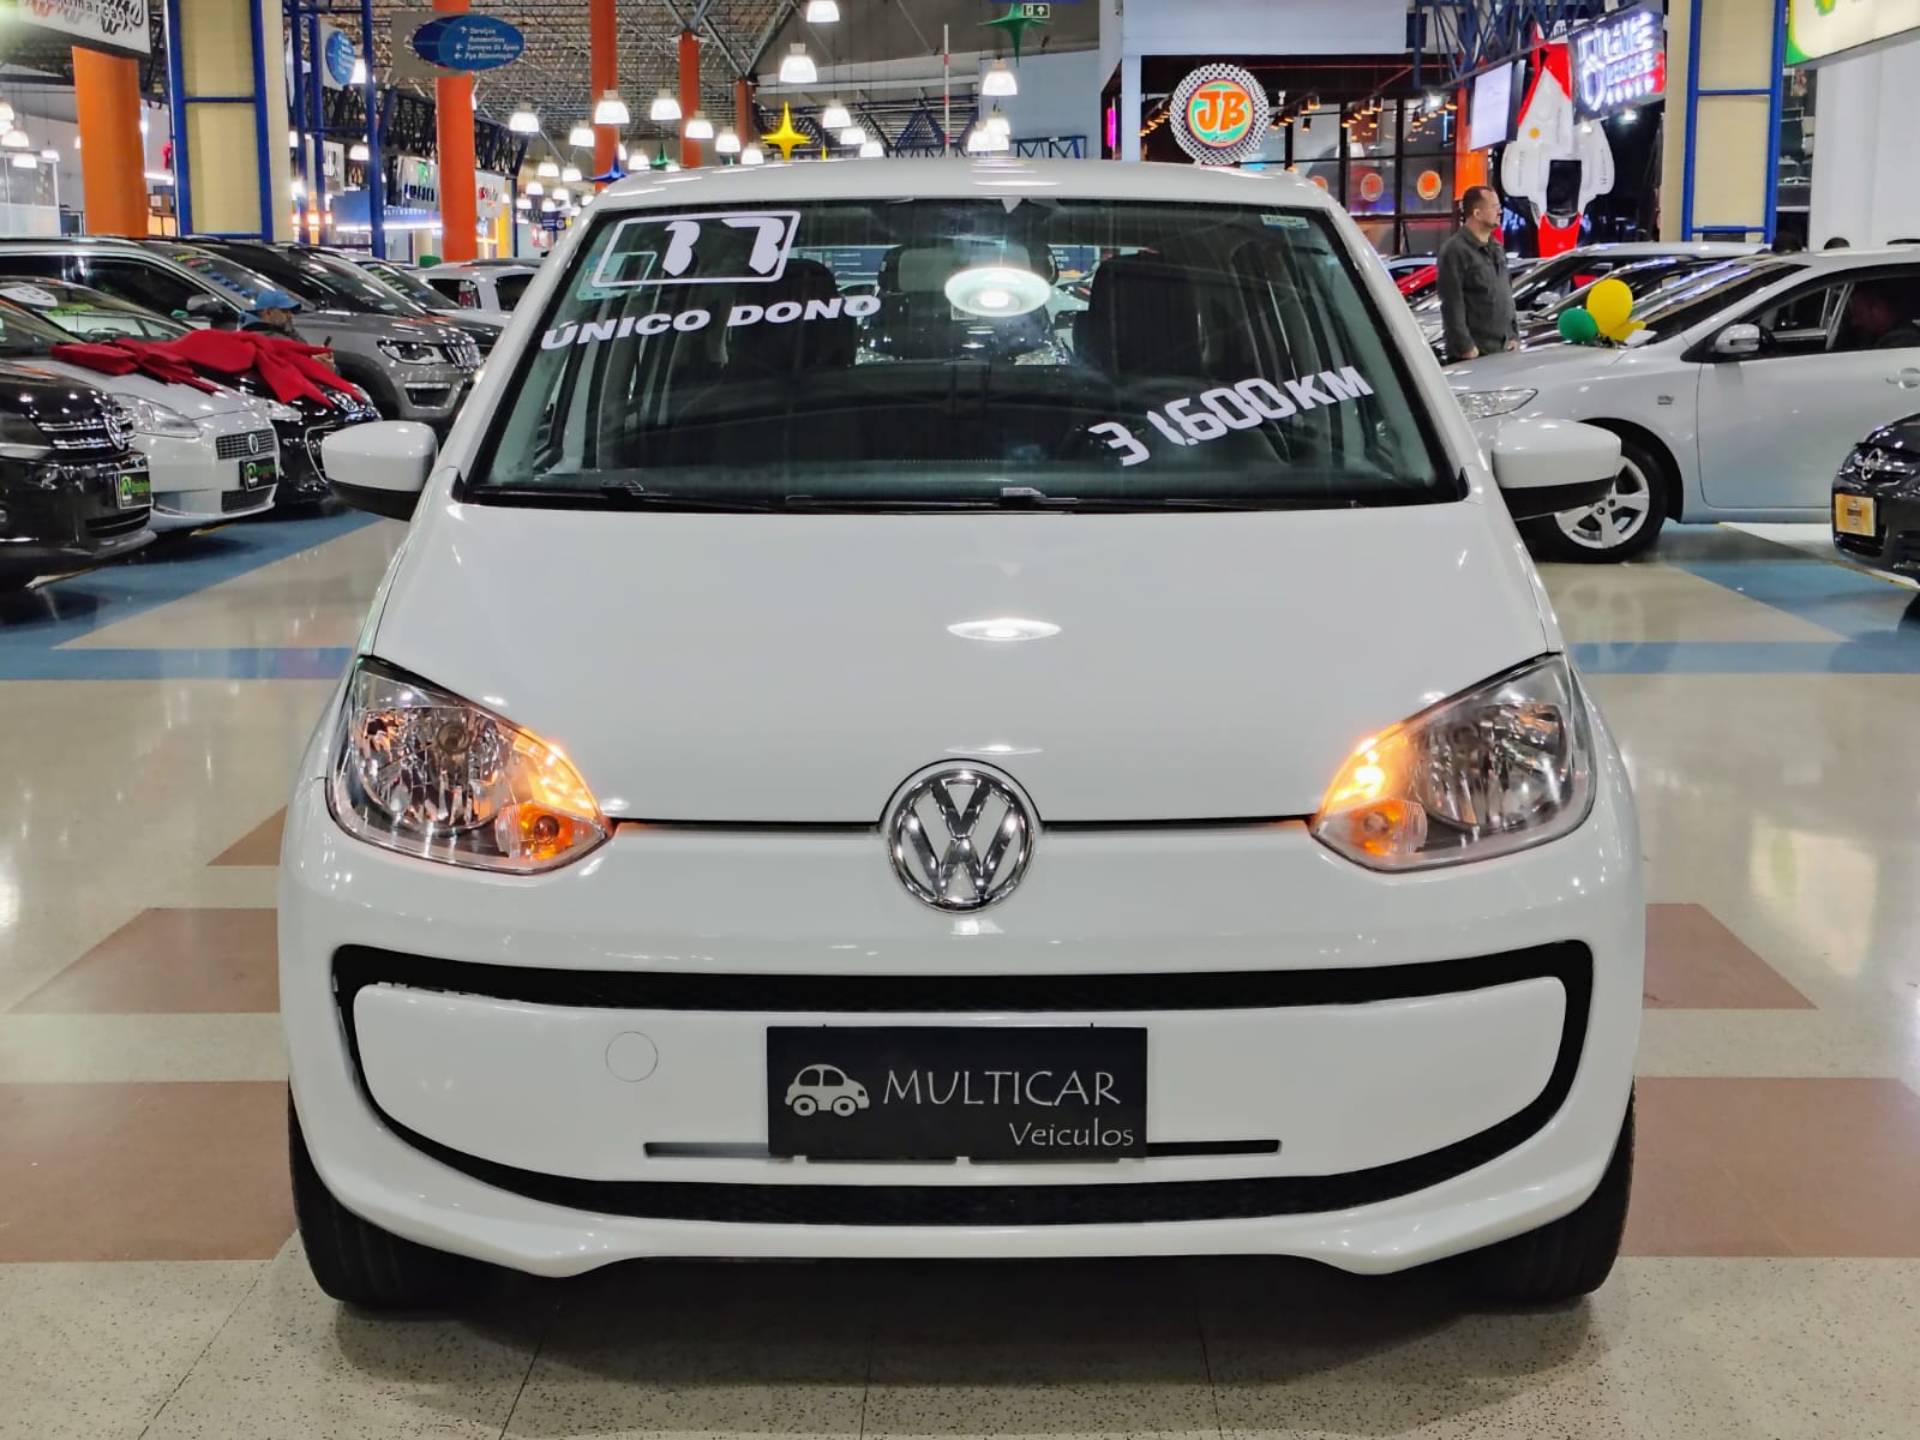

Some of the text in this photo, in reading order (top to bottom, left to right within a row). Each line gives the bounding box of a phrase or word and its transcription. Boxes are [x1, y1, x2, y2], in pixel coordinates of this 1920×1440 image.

[1197, 90, 1246, 131] JB
[540, 294, 881, 350] ÚNICO DONO
[882, 1069, 1122, 1107] MULTICAR
[1008, 1116, 1135, 1147] Veiculos
